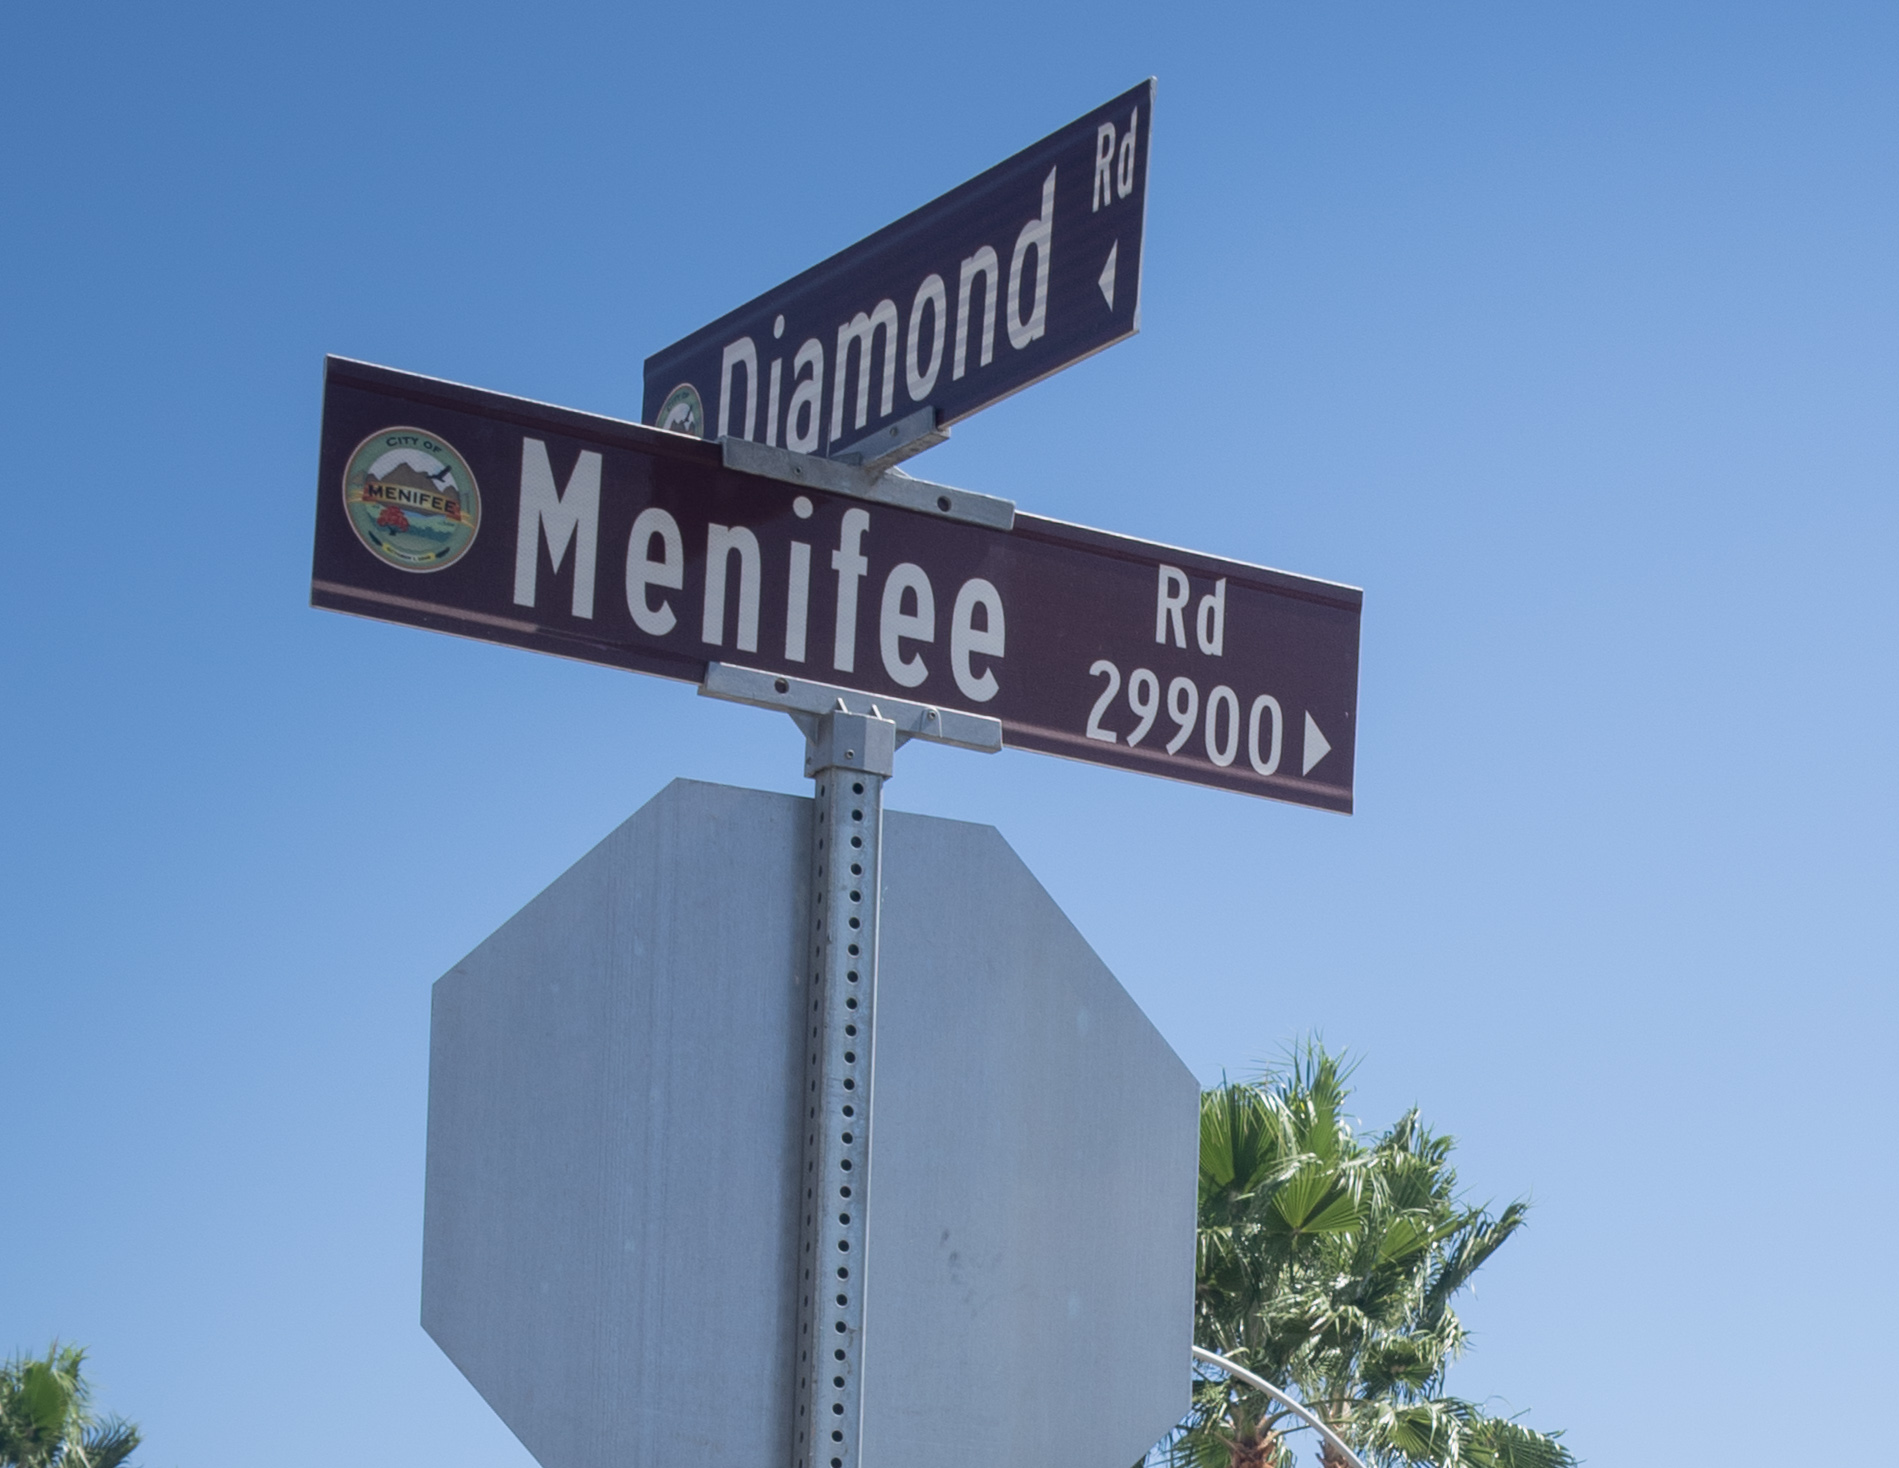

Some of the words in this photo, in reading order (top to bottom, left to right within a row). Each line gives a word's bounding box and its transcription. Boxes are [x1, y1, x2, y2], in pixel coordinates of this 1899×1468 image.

[717, 166, 1057, 456] Diamond
[1092, 107, 1138, 213] Rd
[368, 484, 457, 515] MENIFEE
[386, 436, 419, 447] CITY
[423, 440, 442, 453] OF
[513, 437, 1006, 703] Menifee
[1155, 563, 1227, 657] Rd
[1085, 659, 1283, 776] 29900
